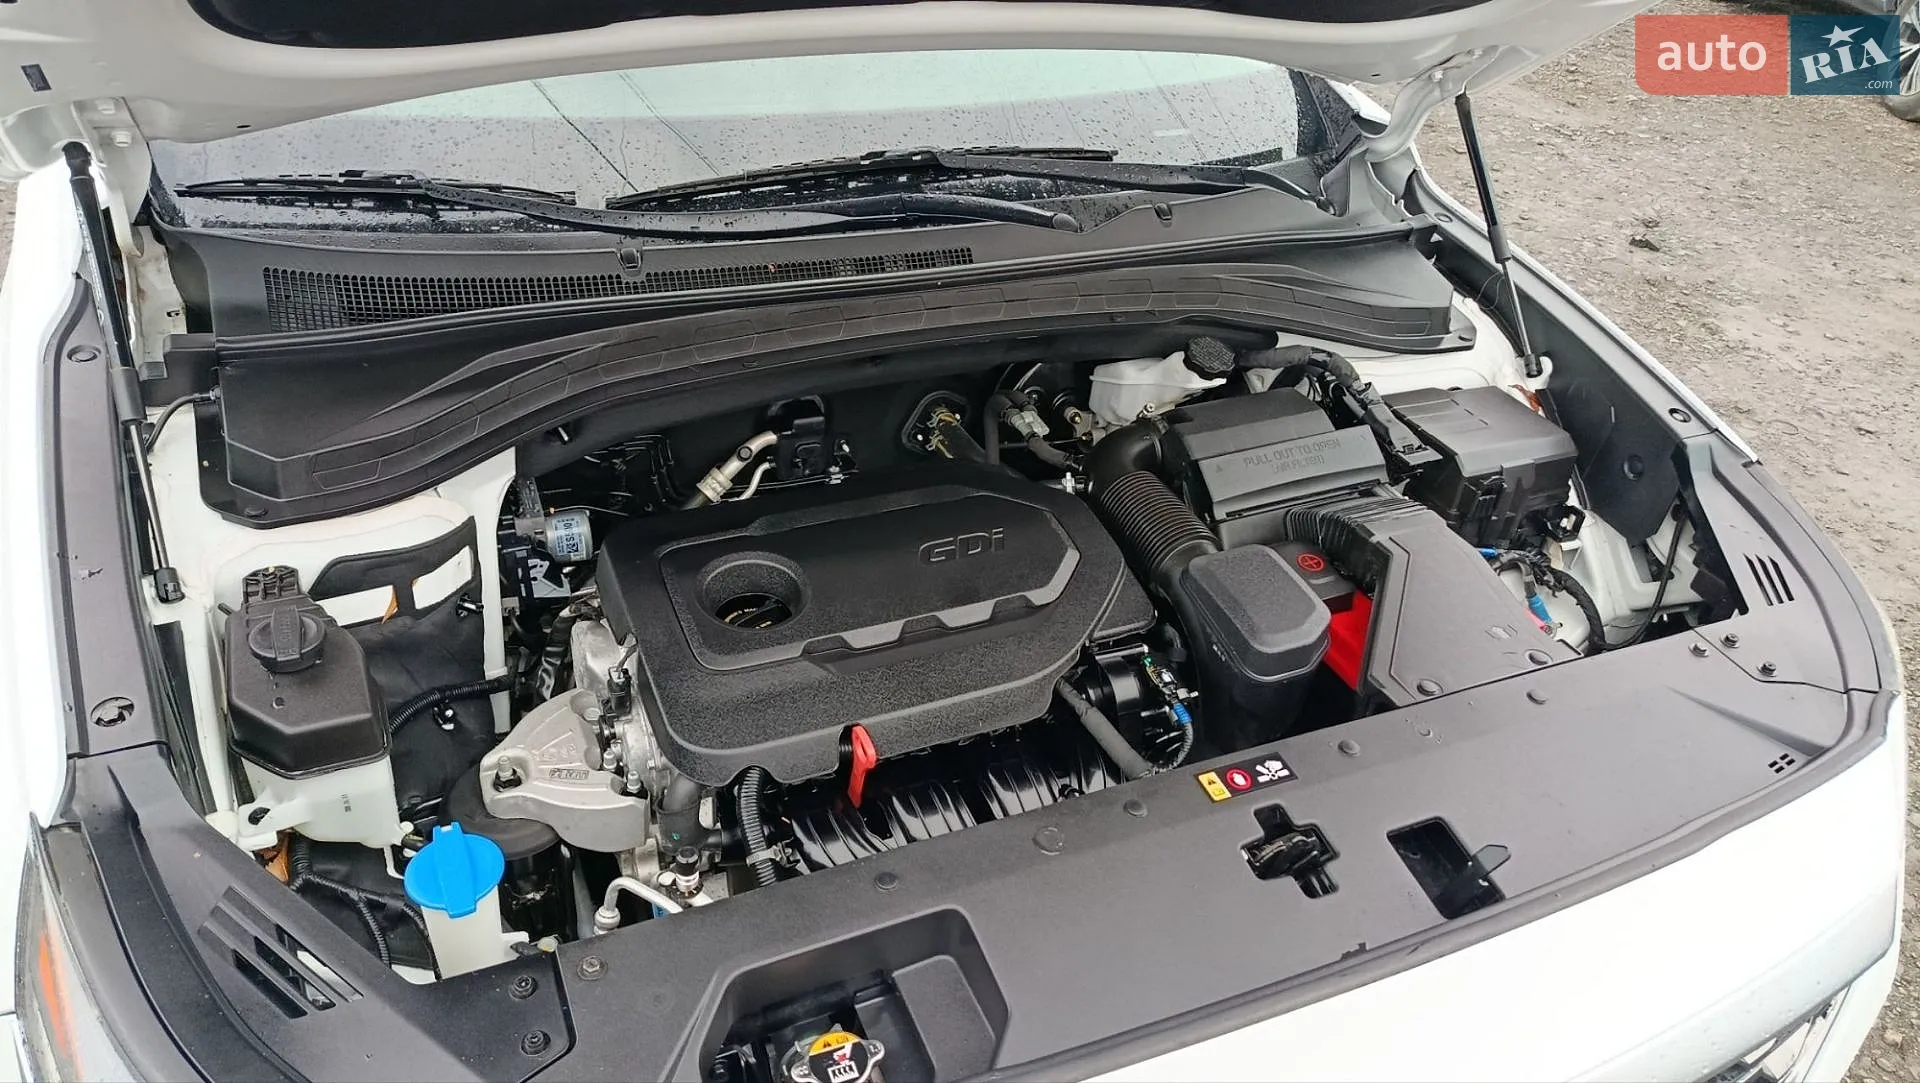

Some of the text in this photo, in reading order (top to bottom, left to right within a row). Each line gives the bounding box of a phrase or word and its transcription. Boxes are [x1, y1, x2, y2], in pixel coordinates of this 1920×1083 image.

[1243, 453, 1273, 469] PULL
[1273, 448, 1295, 461] OUT
[1295, 444, 1311, 455] TO
[919, 528, 1004, 563] GDi
